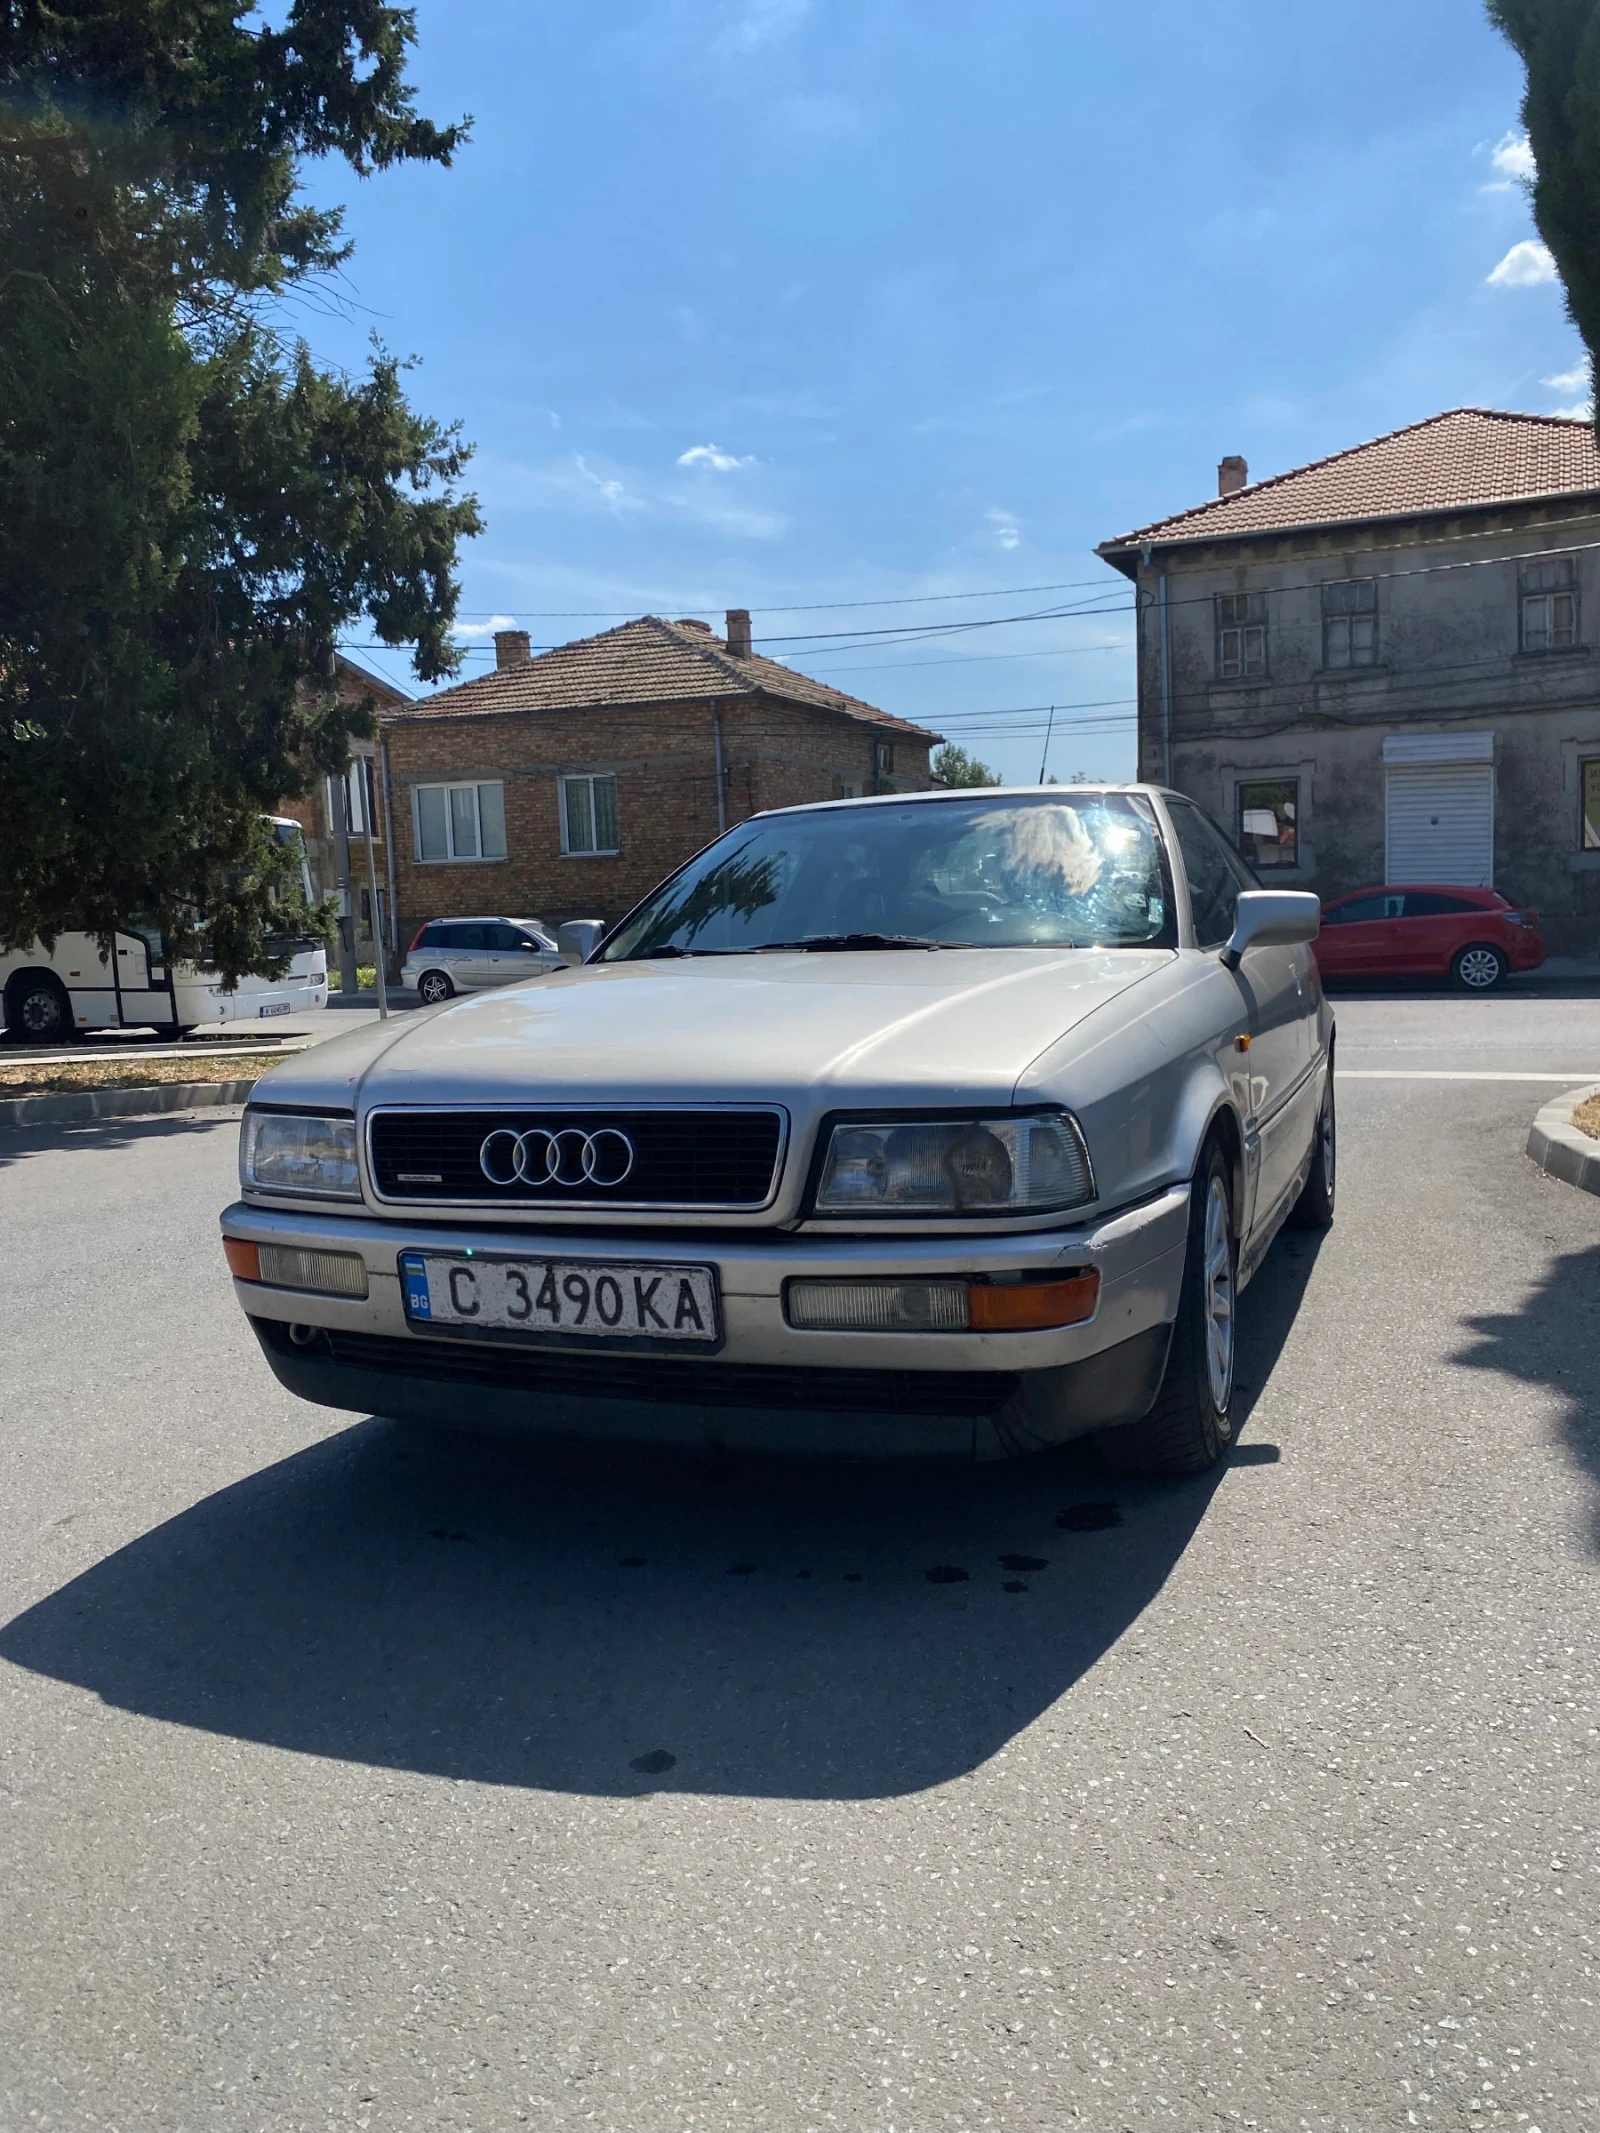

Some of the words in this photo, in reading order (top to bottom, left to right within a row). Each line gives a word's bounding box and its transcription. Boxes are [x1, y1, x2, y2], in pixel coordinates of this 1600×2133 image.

[410, 1293, 428, 1309] BG
[449, 1267, 480, 1317] C
[506, 1269, 624, 1326] 3490
[633, 1276, 705, 1331] KA
